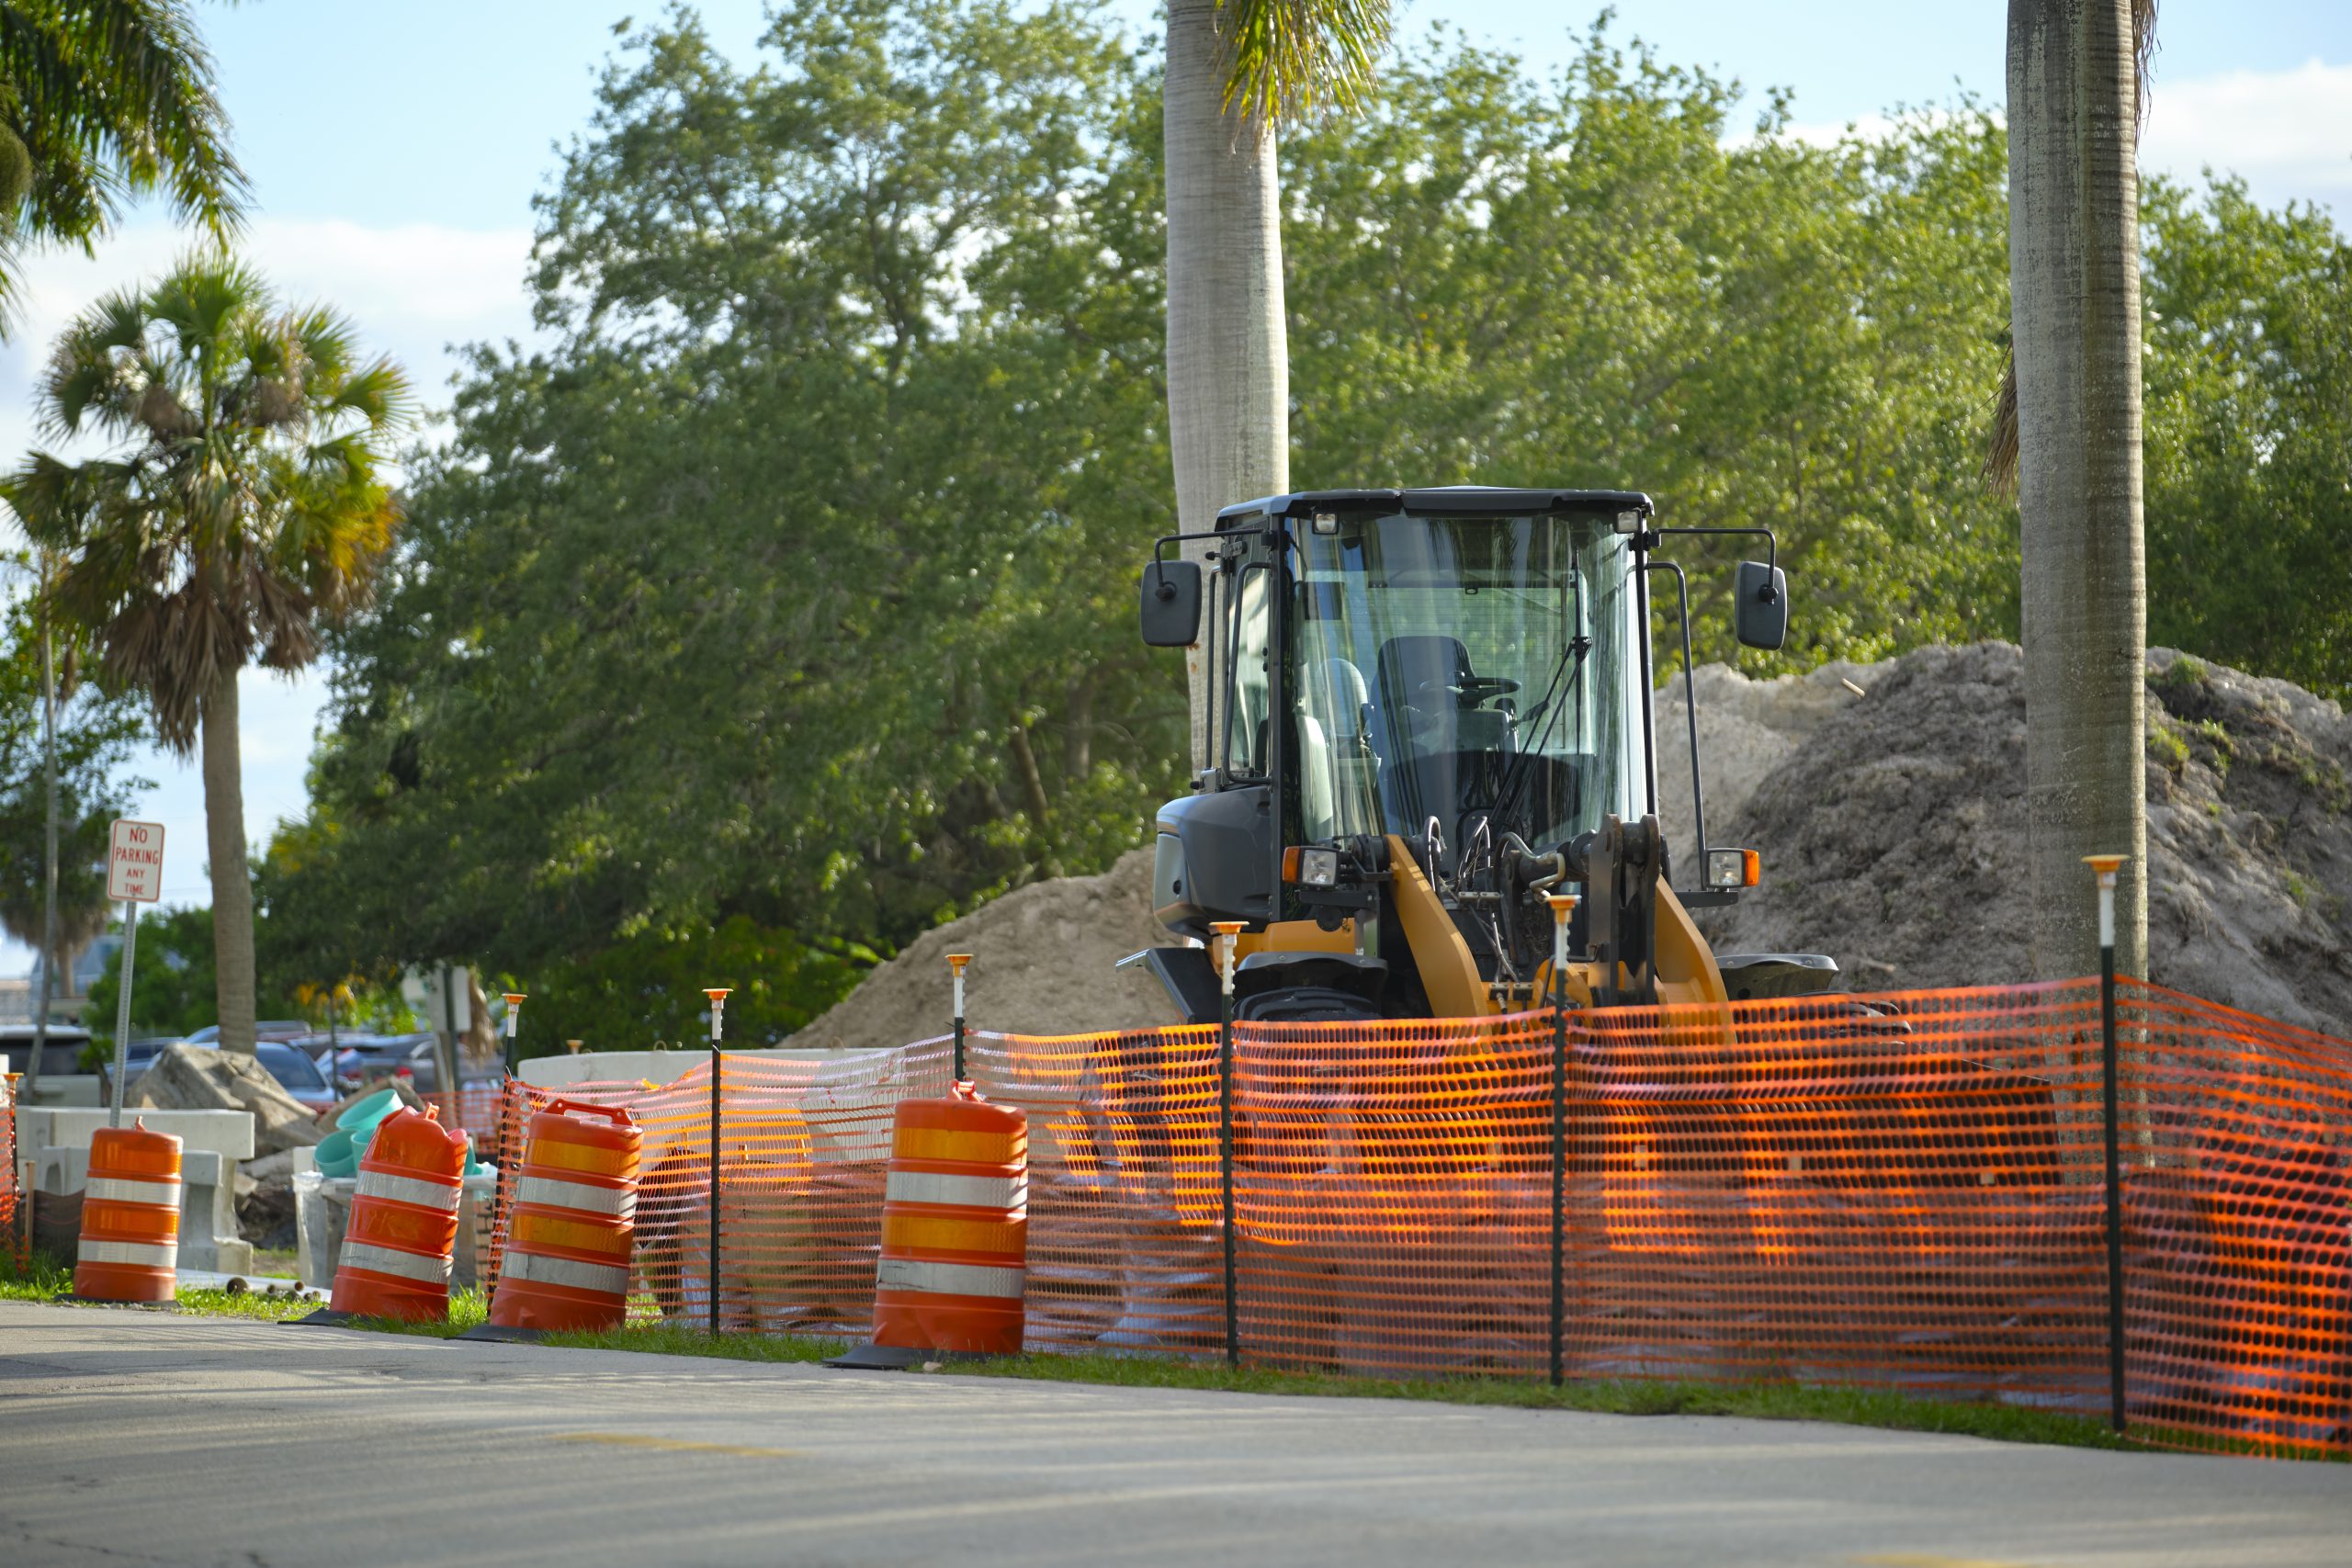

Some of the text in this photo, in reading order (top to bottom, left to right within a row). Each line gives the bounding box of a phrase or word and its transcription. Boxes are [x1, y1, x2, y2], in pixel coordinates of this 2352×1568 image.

[130, 828, 148, 843] NO
[116, 846, 158, 865] PARKING
[126, 868, 145, 878] ANY
[125, 883, 144, 895] TIME
